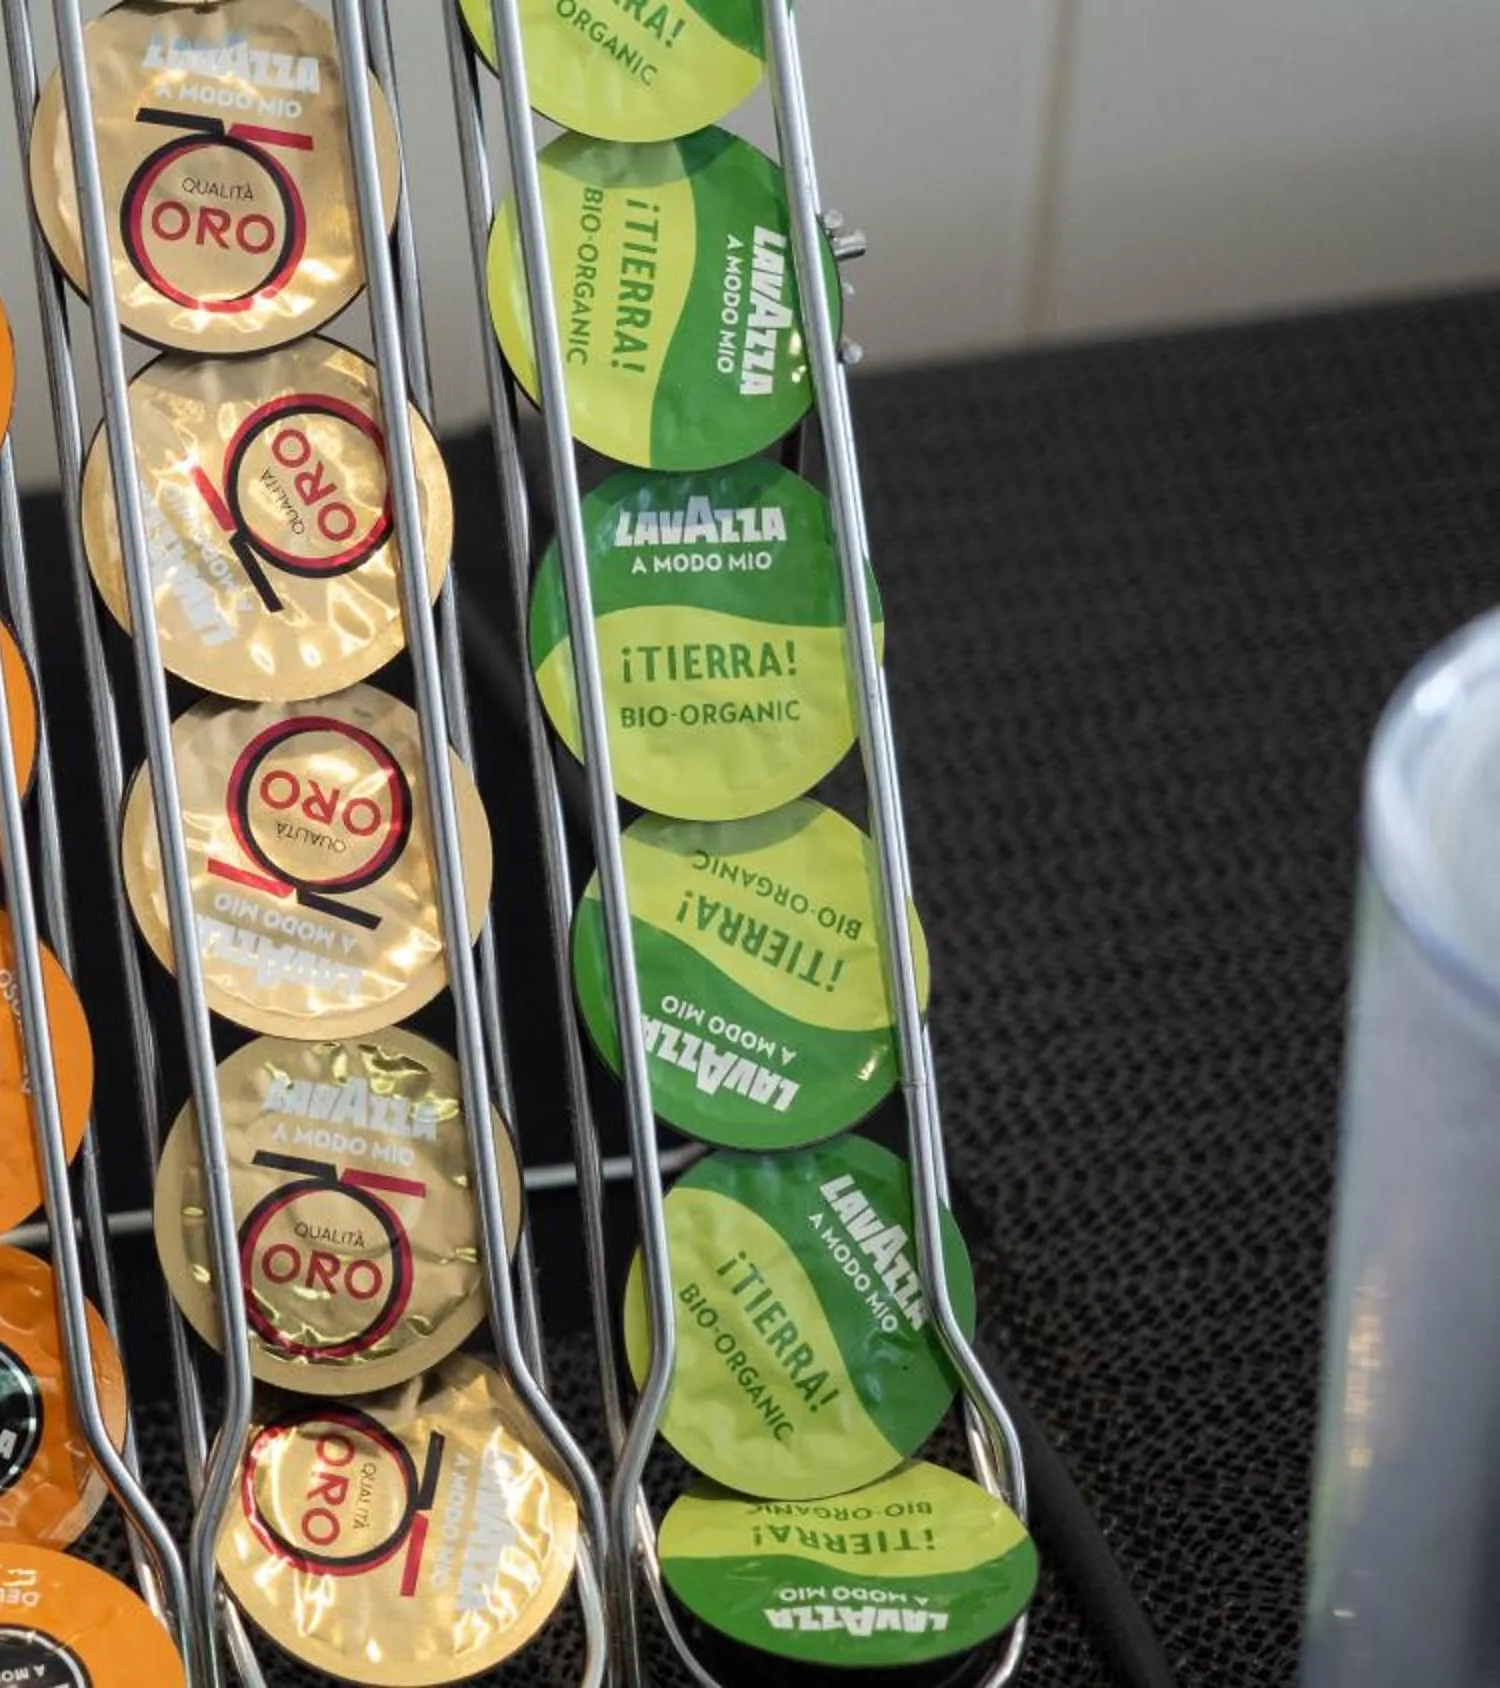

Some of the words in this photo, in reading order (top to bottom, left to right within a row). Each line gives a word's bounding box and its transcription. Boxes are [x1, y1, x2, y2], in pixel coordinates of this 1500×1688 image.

[141, 33, 320, 95] LAVAZZA
[556, 0, 658, 86] ORGANIC
[181, 177, 255, 200] QUALITÀ
[151, 200, 275, 254] ORO
[727, 233, 744, 250] A
[567, 187, 603, 365] BIO-ORGANIC
[611, 199, 660, 373] ¡TIERRA!
[721, 256, 742, 325] MODO
[740, 225, 793, 395] LAVAZZA
[716, 329, 737, 374] MIO
[271, 428, 356, 541] ORO
[614, 495, 788, 547] LAVAZZA
[631, 557, 647, 574] A
[654, 553, 721, 573] MODO
[729, 551, 772, 571] MIO
[621, 640, 797, 683] ¡TIERRA!
[621, 700, 801, 728] BIO-ORGANIC
[260, 770, 381, 836] ORO
[276, 821, 347, 853] QUALITÀ
[213, 892, 258, 919] MIO
[691, 850, 863, 940] BIO-ORGANIC
[263, 912, 336, 946] MODO
[676, 890, 845, 992] ¡TIERRA!
[661, 995, 705, 1026] MIO
[708, 1016, 777, 1059] MODO
[782, 1046, 797, 1066] A
[293, 1221, 365, 1248] QUALITÀ
[261, 1243, 383, 1300] ORO
[808, 1212, 825, 1230] A
[821, 1228, 871, 1291] MODO
[866, 1292, 899, 1333] MIO
[716, 1251, 839, 1412] ¡TIERRA!
[679, 1283, 794, 1441] BIO-ORGANIC
[301, 1434, 355, 1546] ORO
[352, 1462, 377, 1530] QUALITÀ
[753, 1522, 935, 1555] ¡TIERRA!
[779, 1586, 825, 1603] MIO
[831, 1586, 906, 1604] MODO
[915, 1596, 930, 1607] A
[763, 1605, 949, 1637] LAVAZZA
[36, 1664, 46, 1678] A
